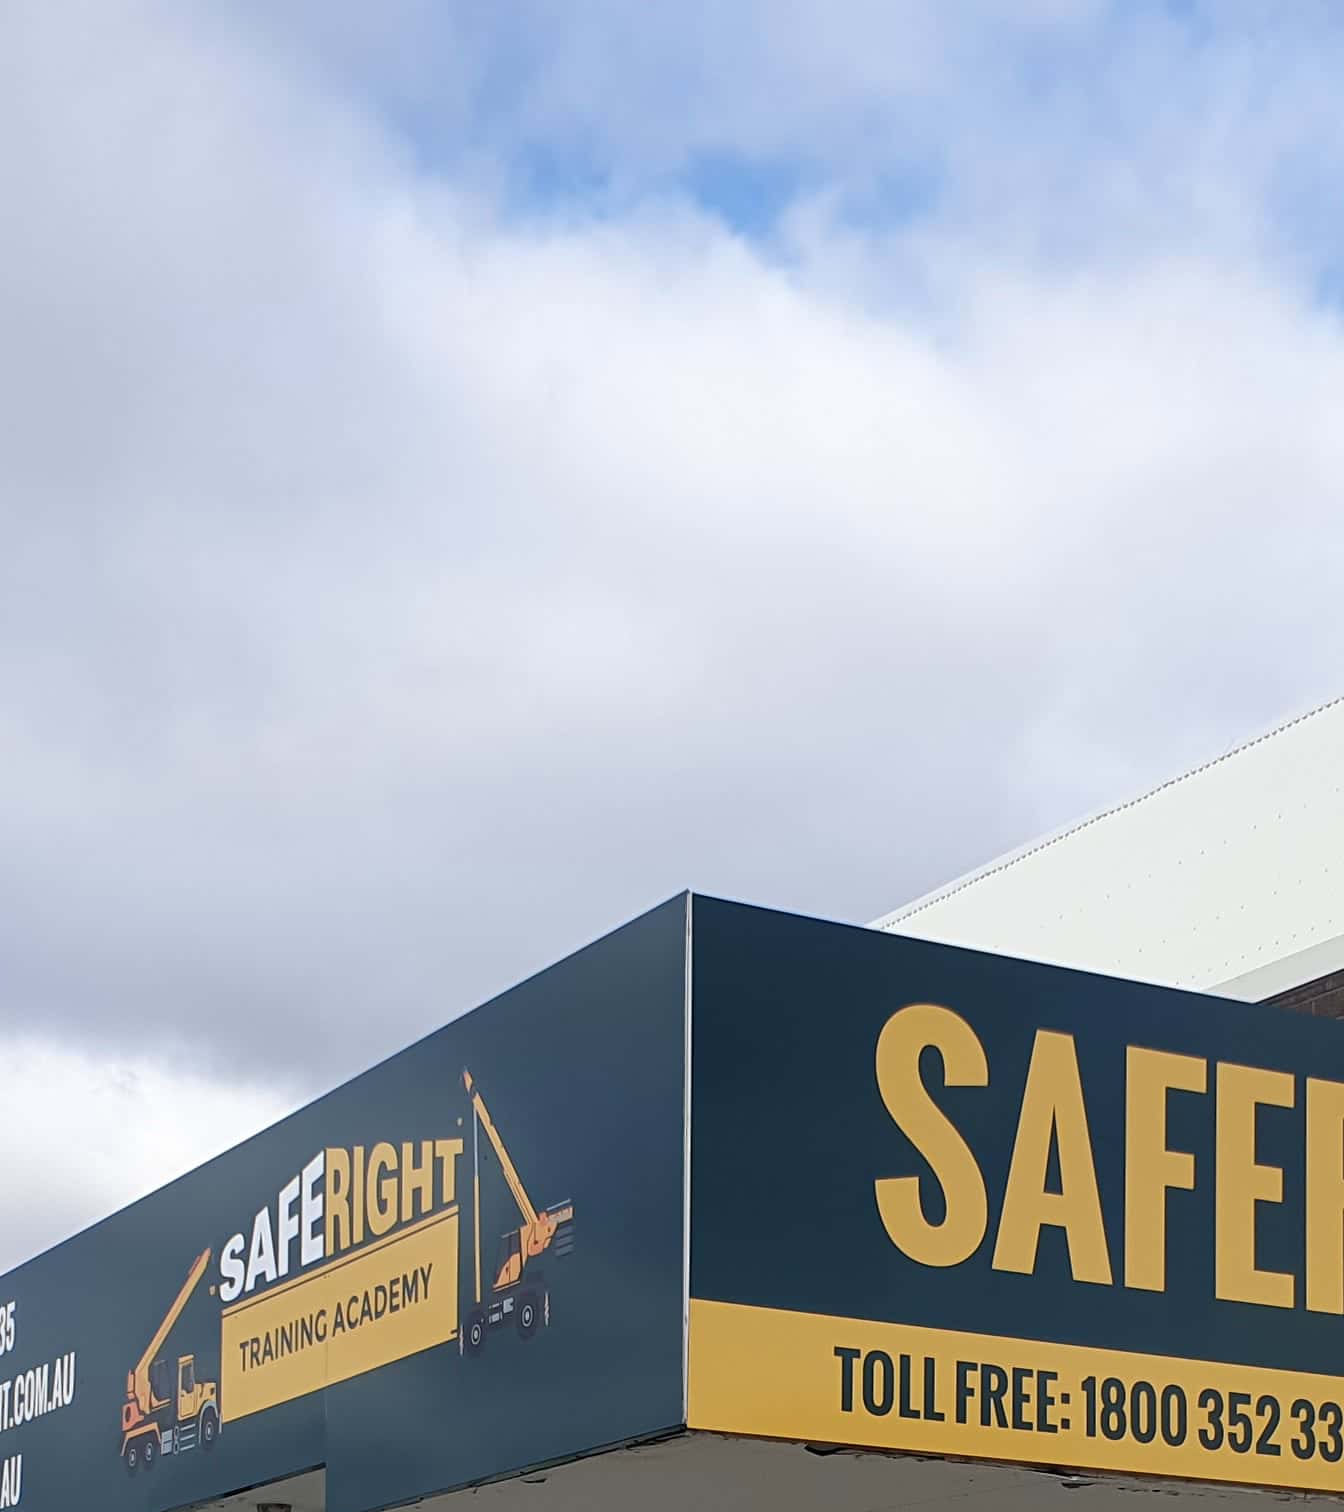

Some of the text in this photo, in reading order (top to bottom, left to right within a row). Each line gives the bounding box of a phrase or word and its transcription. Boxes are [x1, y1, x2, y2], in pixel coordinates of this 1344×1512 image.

[218, 1138, 464, 1302] SAFERIGHT
[239, 1263, 433, 1373] TRAINING ACADEMY
[834, 1346, 944, 1422] TOLL
[956, 1361, 1072, 1433] FREE:
[1082, 1375, 1187, 1447] 1800
[1198, 1389, 1281, 1457] 352
